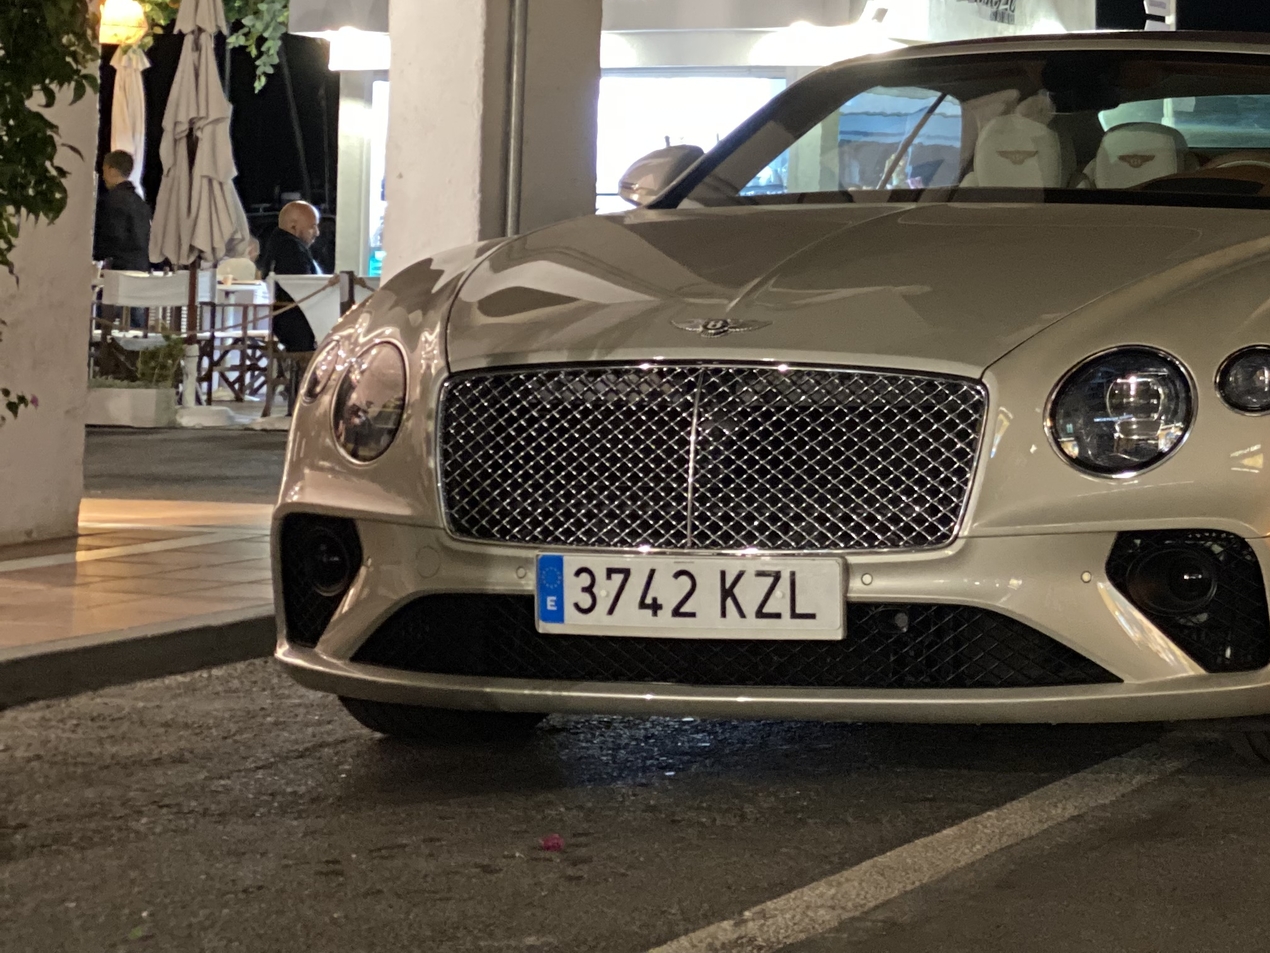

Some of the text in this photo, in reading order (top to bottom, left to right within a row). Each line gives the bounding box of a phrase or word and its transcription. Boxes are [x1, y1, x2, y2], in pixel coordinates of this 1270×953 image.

[546, 596, 557, 611] E
[572, 565, 817, 620] 3742 KZL
